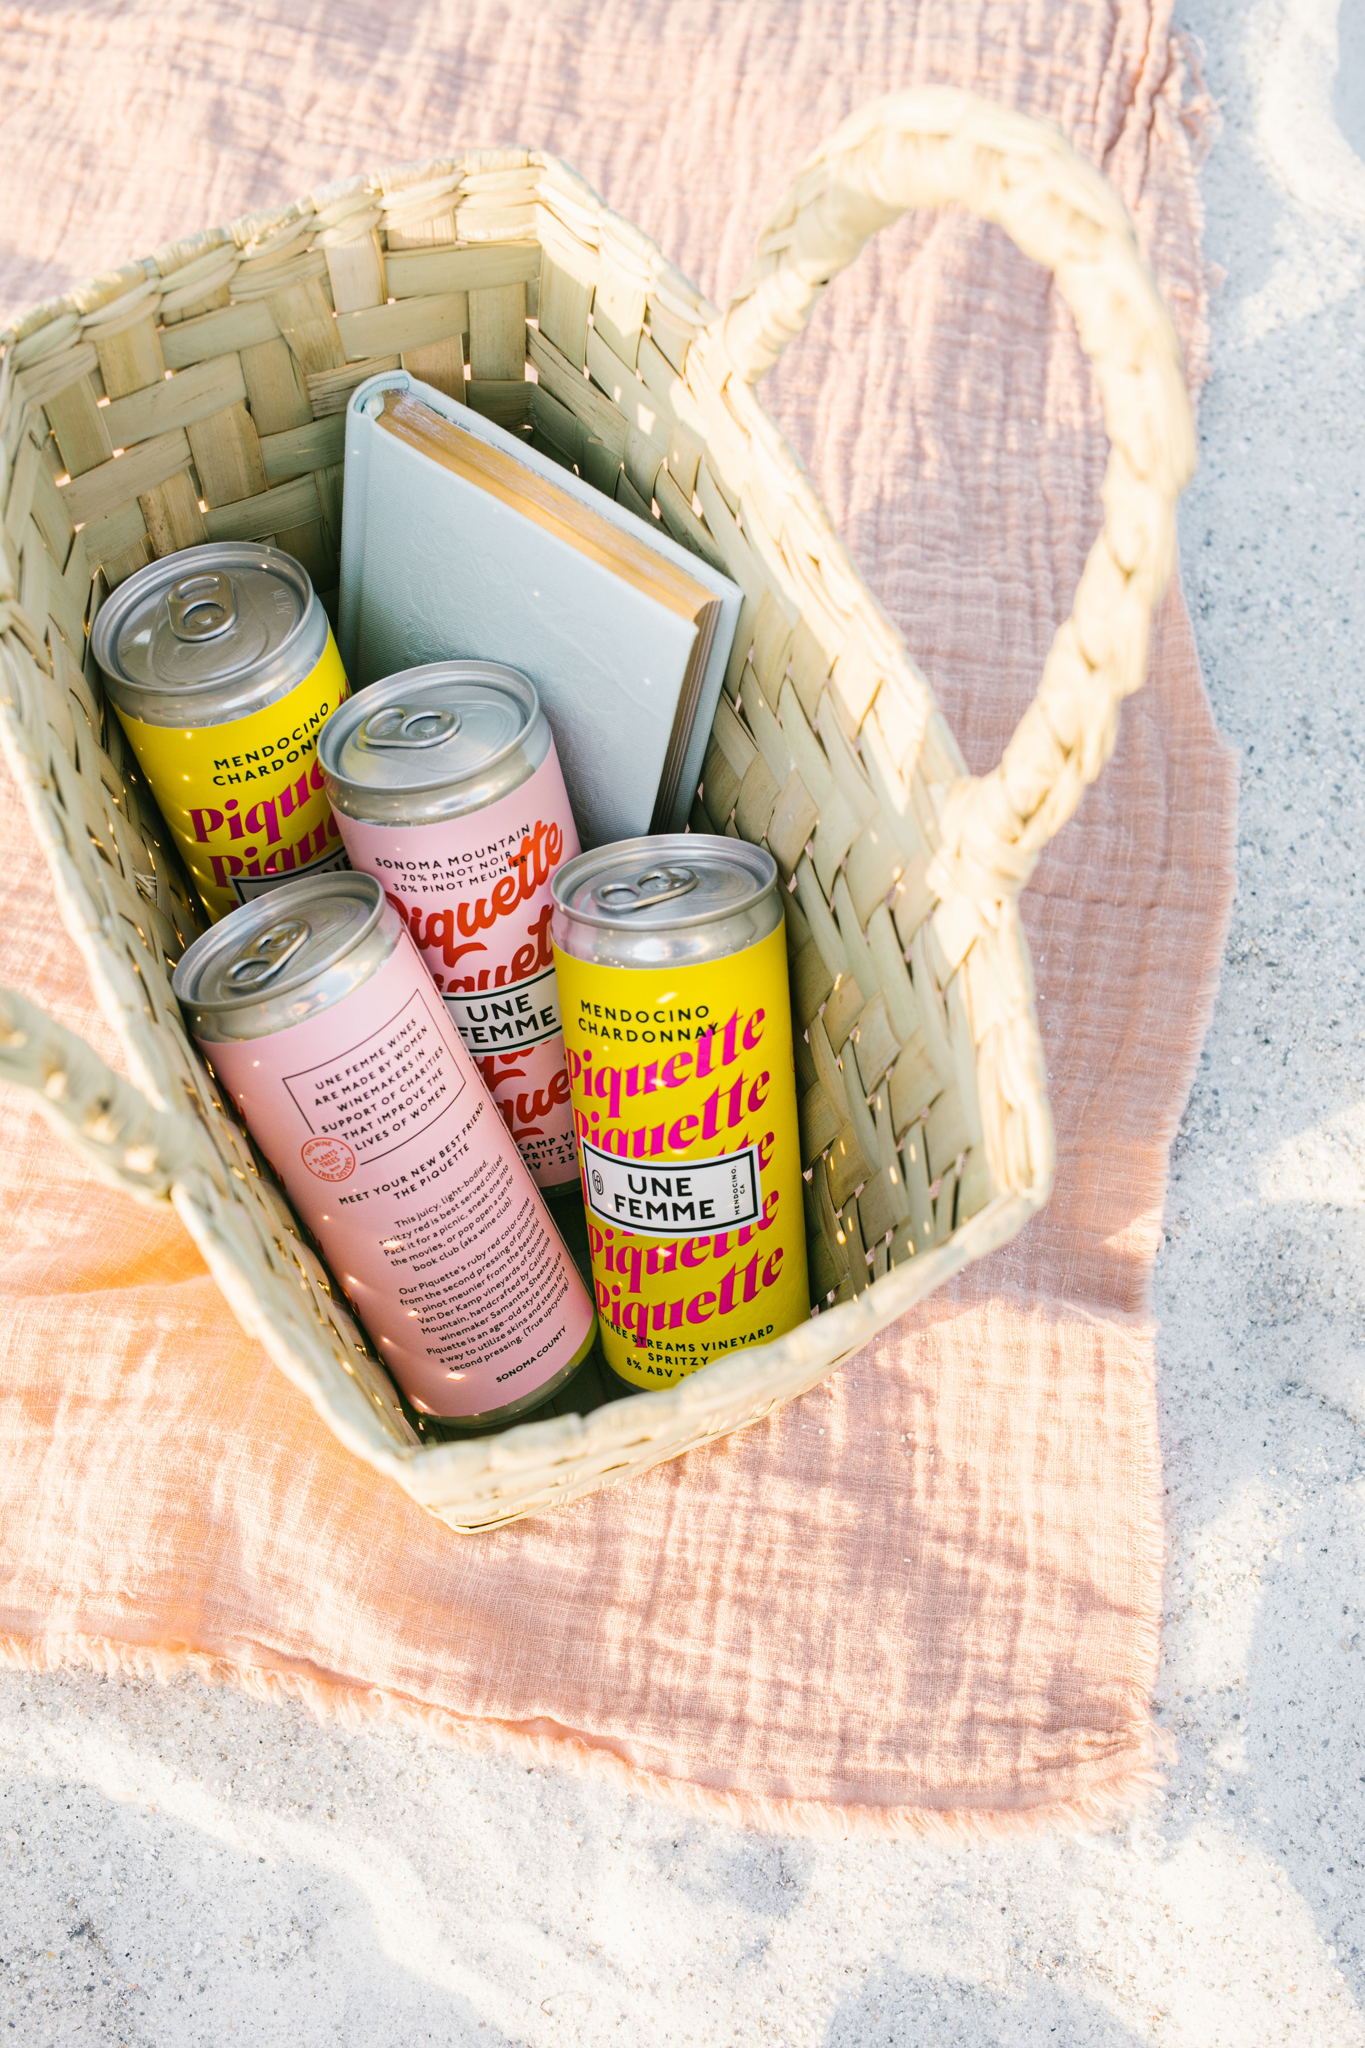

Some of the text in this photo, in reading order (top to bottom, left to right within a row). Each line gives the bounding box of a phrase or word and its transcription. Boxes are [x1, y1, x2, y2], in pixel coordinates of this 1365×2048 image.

[213, 702, 329, 770] MENDOCINO
[375, 857, 442, 871] SONOMA
[448, 824, 530, 866] MOUNTAIN
[393, 855, 527, 893] 30% PINOT MEUNIER
[402, 851, 512, 881] 70% PINOT NOIR
[457, 1005, 557, 1043] FEMME
[466, 993, 533, 1022] UNE
[578, 1018, 718, 1043] CHARDONNAY
[580, 999, 709, 1023] MENDOCINO
[315, 1018, 416, 1090] UNE FEMME WINES
[315, 1025, 427, 1106] ARE MADE BY WOMEN
[336, 1049, 425, 1112] WINEMAKERS IN
[566, 1006, 766, 1118] Piquette
[321, 1103, 377, 1133] SUPPORT
[381, 1091, 396, 1105] OF
[400, 1046, 443, 1092] CHARITIES
[342, 1067, 443, 1140] THAT IMPROVE THE
[354, 1083, 447, 1151] LIVES OF WOMEN
[338, 1191, 370, 1205] MEET
[373, 1175, 408, 1195] YOUR
[410, 1156, 436, 1177] NEW
[438, 1134, 461, 1158] BEST
[393, 1143, 470, 1200] THE PIQUETTE
[559, 1151, 578, 1164] 25
[627, 1173, 693, 1197] UNE
[384, 1245, 406, 1256] Pack
[416, 1234, 431, 1245] for
[468, 1192, 489, 1214] sneak
[489, 1179, 500, 1194] one
[500, 1164, 509, 1180] into
[394, 1216, 416, 1228] This
[416, 1203, 441, 1221] juicy,
[414, 1221, 430, 1234] red
[431, 1217, 439, 1225] is
[439, 1203, 460, 1220] best
[460, 1179, 485, 1205] served
[614, 1193, 716, 1222] FEMME
[739, 1184, 745, 1195] CA
[390, 1257, 408, 1266] the
[446, 1234, 456, 1243] or
[458, 1222, 474, 1237] pop
[475, 1204, 494, 1223] open
[497, 1186, 508, 1201] can
[506, 1174, 514, 1187] for
[399, 1196, 530, 1295] Our Piquette's ruby red color comes
[412, 1257, 438, 1272] book
[439, 1246, 459, 1261] club
[460, 1234, 478, 1249] (aka
[478, 1217, 496, 1235] wine
[400, 1203, 536, 1306] from the second pressing of pinot noir
[421, 1300, 448, 1314] pinot
[448, 1279, 486, 1303] meunier
[486, 1263, 507, 1282] from
[506, 1251, 519, 1265] the
[518, 1218, 540, 1252] beautiful
[417, 1316, 436, 1324] Van
[436, 1309, 454, 1319] Der
[455, 1296, 482, 1312] Kamp
[483, 1265, 520, 1297] vineyards
[520, 1255, 527, 1267] of
[421, 1236, 550, 1335] Mountain, handcrafted by California
[426, 1340, 467, 1355] Piquette
[477, 1331, 488, 1339] an
[489, 1307, 522, 1332] age-old
[522, 1290, 540, 1310] style
[539, 1257, 559, 1293] invented
[439, 1316, 489, 1342] winemaker
[490, 1286, 529, 1319] Samantha
[595, 1247, 784, 1348] Piquette
[445, 1352, 464, 1362] way
[465, 1348, 476, 1356] to
[477, 1333, 506, 1351] utilize
[506, 1317, 528, 1335] skins
[528, 1302, 541, 1319] and
[541, 1282, 558, 1306] stems
[449, 1356, 483, 1372] second
[484, 1336, 524, 1362] pressing.
[523, 1317, 543, 1337] (True
[601, 1312, 774, 1352] THREE STREAMS VINEYARD
[496, 1325, 567, 1383] SONOMA COUNTY
[626, 1357, 673, 1377] 8% ABV
[648, 1352, 709, 1365] SPRITZY
